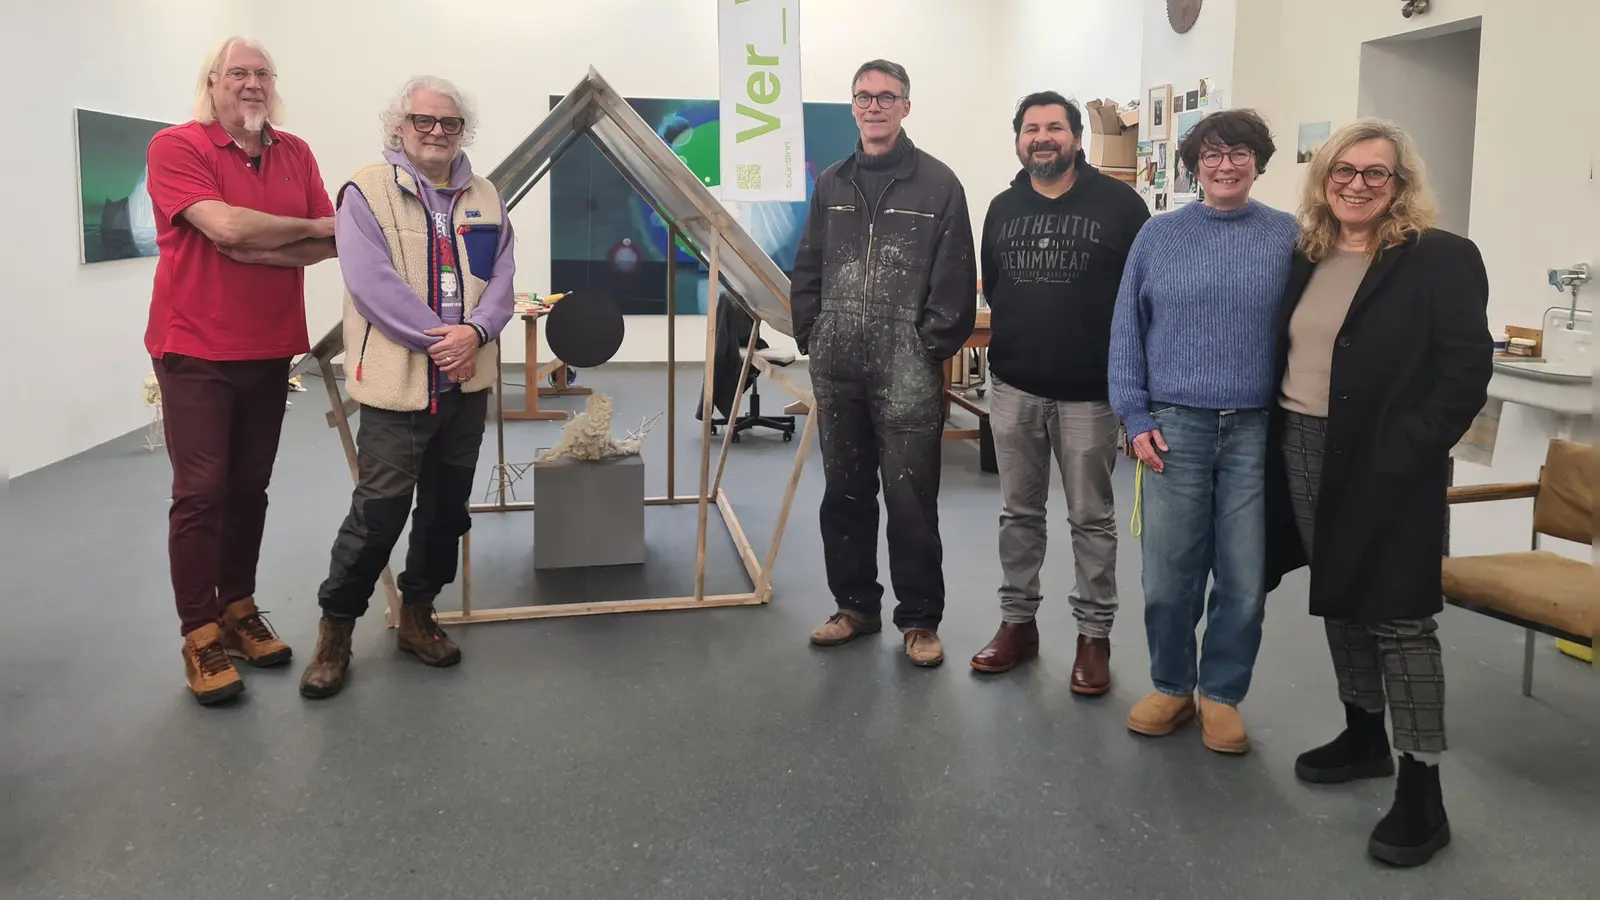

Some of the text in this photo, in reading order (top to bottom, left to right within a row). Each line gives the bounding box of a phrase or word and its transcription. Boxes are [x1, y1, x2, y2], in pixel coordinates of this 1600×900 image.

[735, 0, 786, 144] Ver_
[997, 214, 1101, 243] AUTHENTIC
[1010, 239, 1035, 247] BLACK
[1000, 250, 1090, 271] DENIMWEAR
